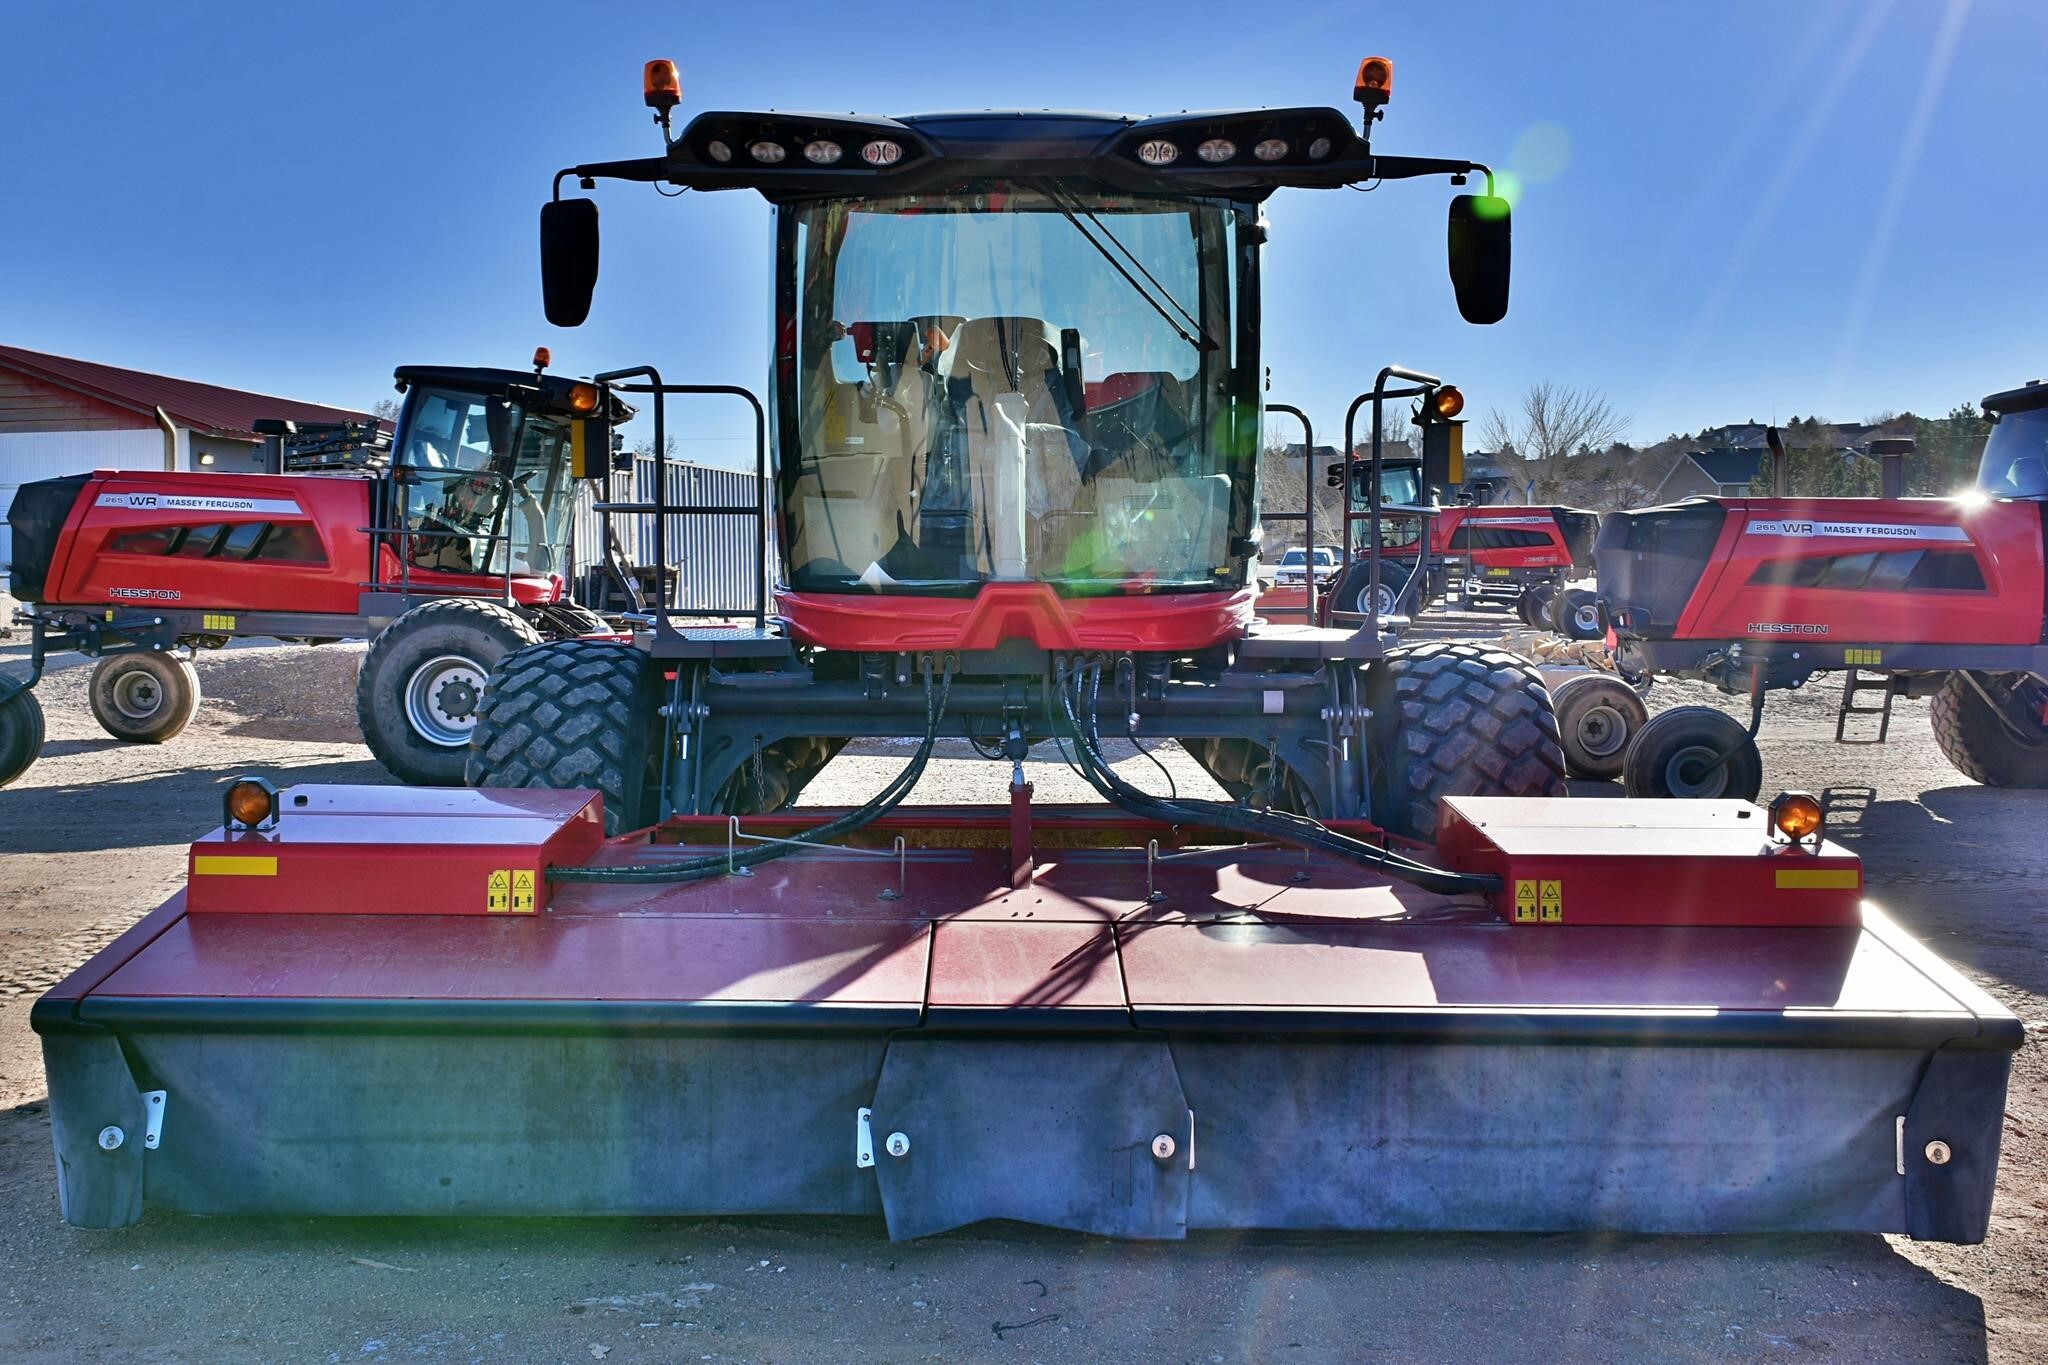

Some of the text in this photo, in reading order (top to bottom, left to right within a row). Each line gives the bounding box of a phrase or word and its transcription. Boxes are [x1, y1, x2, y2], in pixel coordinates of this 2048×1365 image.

[129, 496, 157, 506] WR
[166, 499, 202, 507] MASSEY
[206, 500, 253, 509] FERGUSON
[1782, 523, 1813, 533] WR
[1824, 526, 1863, 534] MASSEY
[1867, 527, 1917, 536] FERGUSON
[110, 588, 180, 599] HESSTON
[1748, 624, 1828, 634] HESSTON
